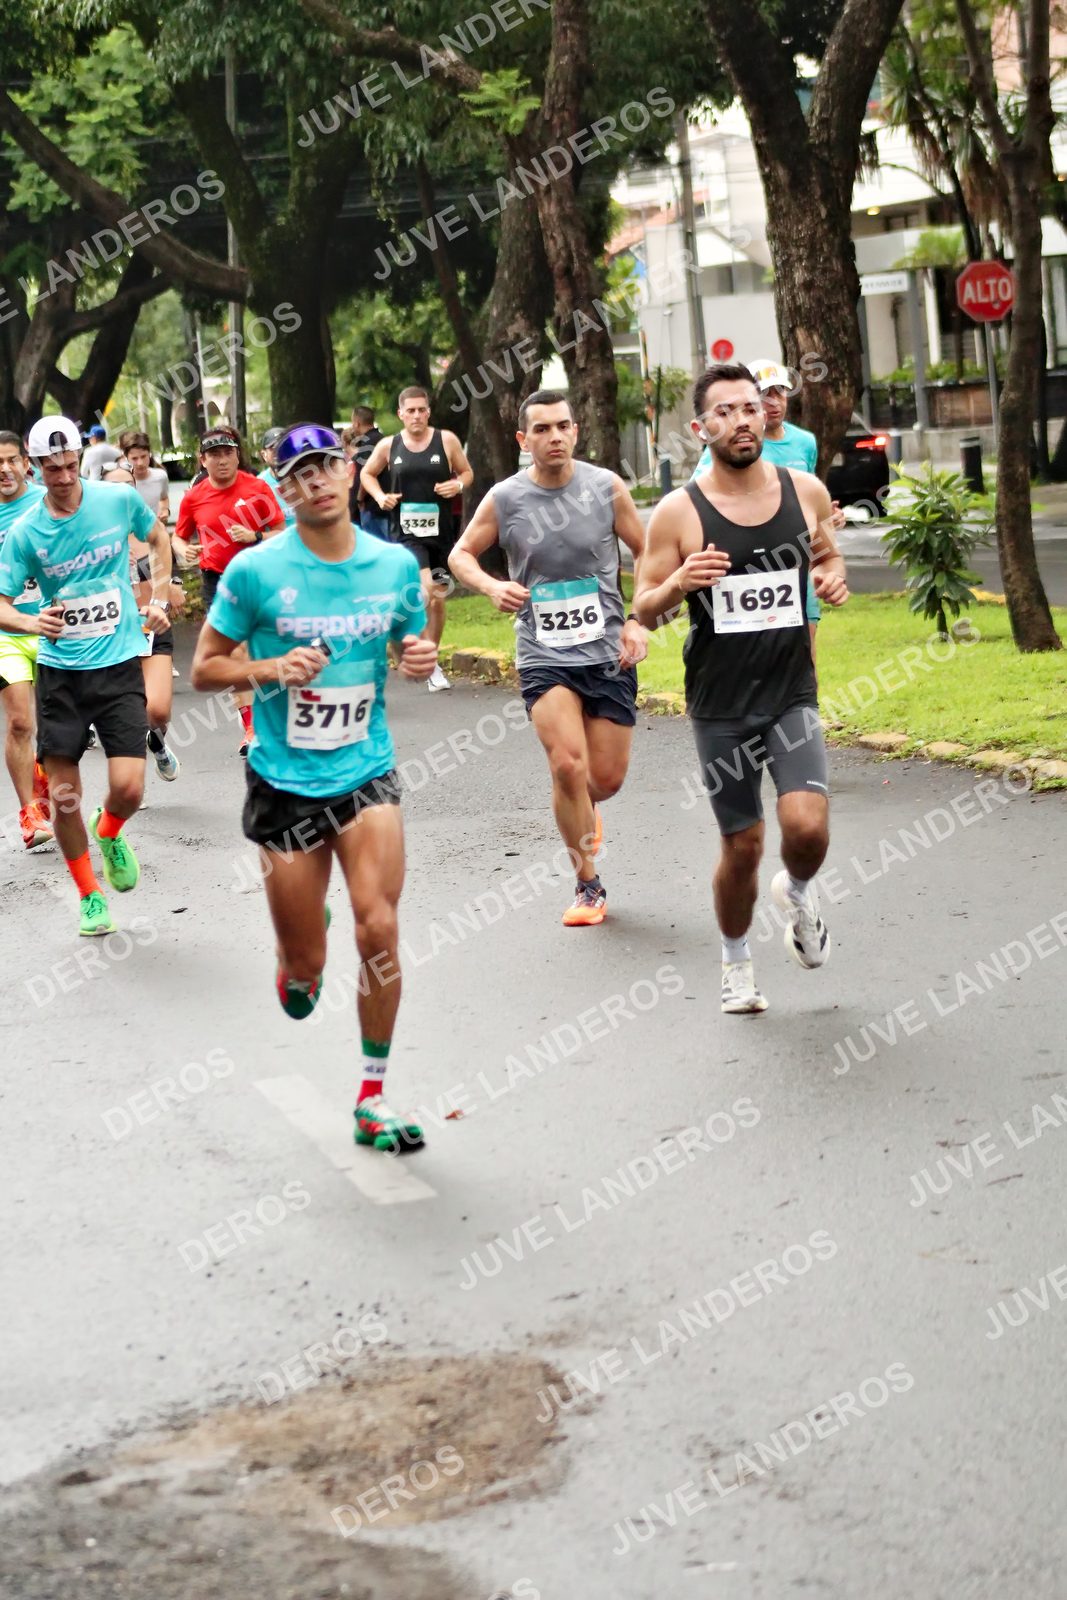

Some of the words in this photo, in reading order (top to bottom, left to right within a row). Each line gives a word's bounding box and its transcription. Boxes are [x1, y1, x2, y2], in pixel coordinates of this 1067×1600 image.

[963, 278, 1012, 304] ALTO
[403, 518, 436, 529] 3326
[721, 584, 794, 613] 1692
[64, 601, 120, 626] 6228
[539, 606, 598, 631] 3236
[295, 699, 369, 728] 3716
